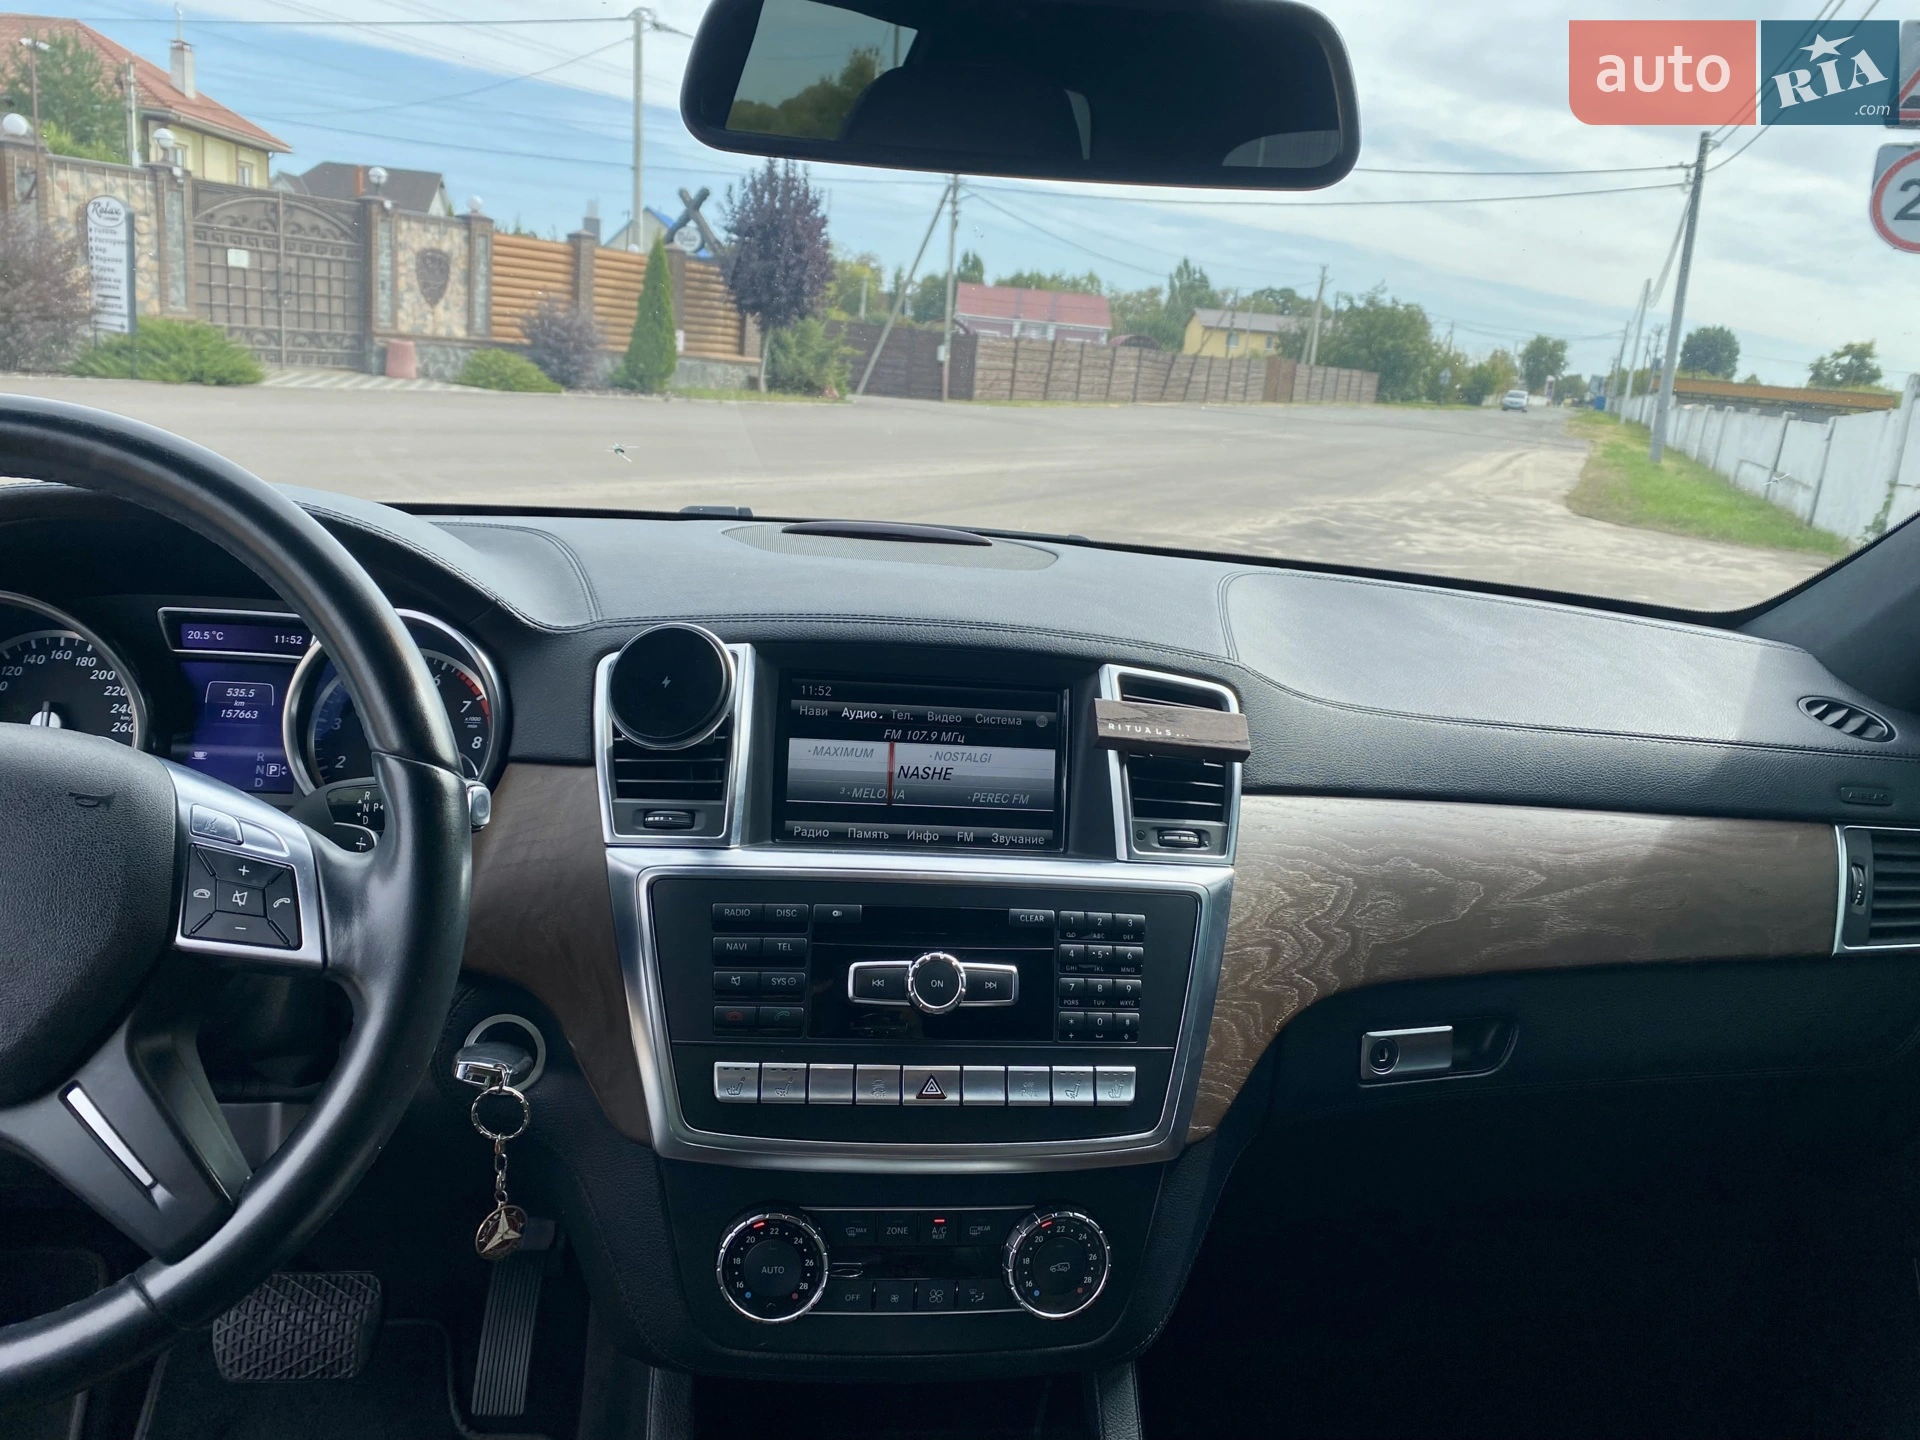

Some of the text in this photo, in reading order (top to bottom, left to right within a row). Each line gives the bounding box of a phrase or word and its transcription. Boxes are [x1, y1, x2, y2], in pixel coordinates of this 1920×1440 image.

[91, 201, 122, 218] Relax
[187, 631, 224, 640] 20.5 °C
[274, 635, 302, 645] 11:52
[23, 654, 45, 664] 140
[50, 650, 72, 660] 160
[75, 657, 96, 667] 180
[1, 666, 23, 676] 120
[90, 670, 116, 680] 200
[434, 674, 441, 686] 6
[104, 686, 127, 696] 220
[226, 688, 255, 698] 535.5
[801, 685, 832, 696] 11:52
[110, 704, 133, 714] 240
[460, 701, 472, 713] 7
[220, 709, 259, 719] 157663
[800, 705, 1022, 725] Нави Аудио Тел. Видео Система
[111, 722, 134, 732] 260
[331, 718, 342, 730] 3
[884, 729, 965, 743] FM 107.9 МГц
[471, 736, 483, 749] 8
[257, 752, 265, 762] R
[812, 746, 874, 758] MAXIMUM
[934, 751, 992, 763] NOSTALGI
[335, 756, 346, 768] 2
[256, 765, 277, 775] N P
[897, 765, 954, 781] NASHE
[255, 778, 263, 788] D
[364, 791, 371, 800] R
[972, 792, 1029, 805] PEREC FM
[363, 803, 379, 812] N P
[363, 815, 369, 824] D
[793, 827, 1045, 846] Радио Память Инфо FM Звучание
[724, 908, 751, 916] RADIO
[776, 909, 797, 917] DISC
[1097, 918, 1102, 926] 2
[1128, 919, 1133, 927] 3
[726, 943, 747, 951] NAVI
[777, 943, 792, 951] TEL
[771, 978, 787, 986] SYS
[930, 979, 944, 988] ON
[1069, 983, 1075, 991] 7
[1097, 984, 1102, 992] 8
[1097, 1018, 1103, 1026] 0
[886, 1227, 908, 1235] ZONE
[761, 1266, 784, 1274] AUTO
